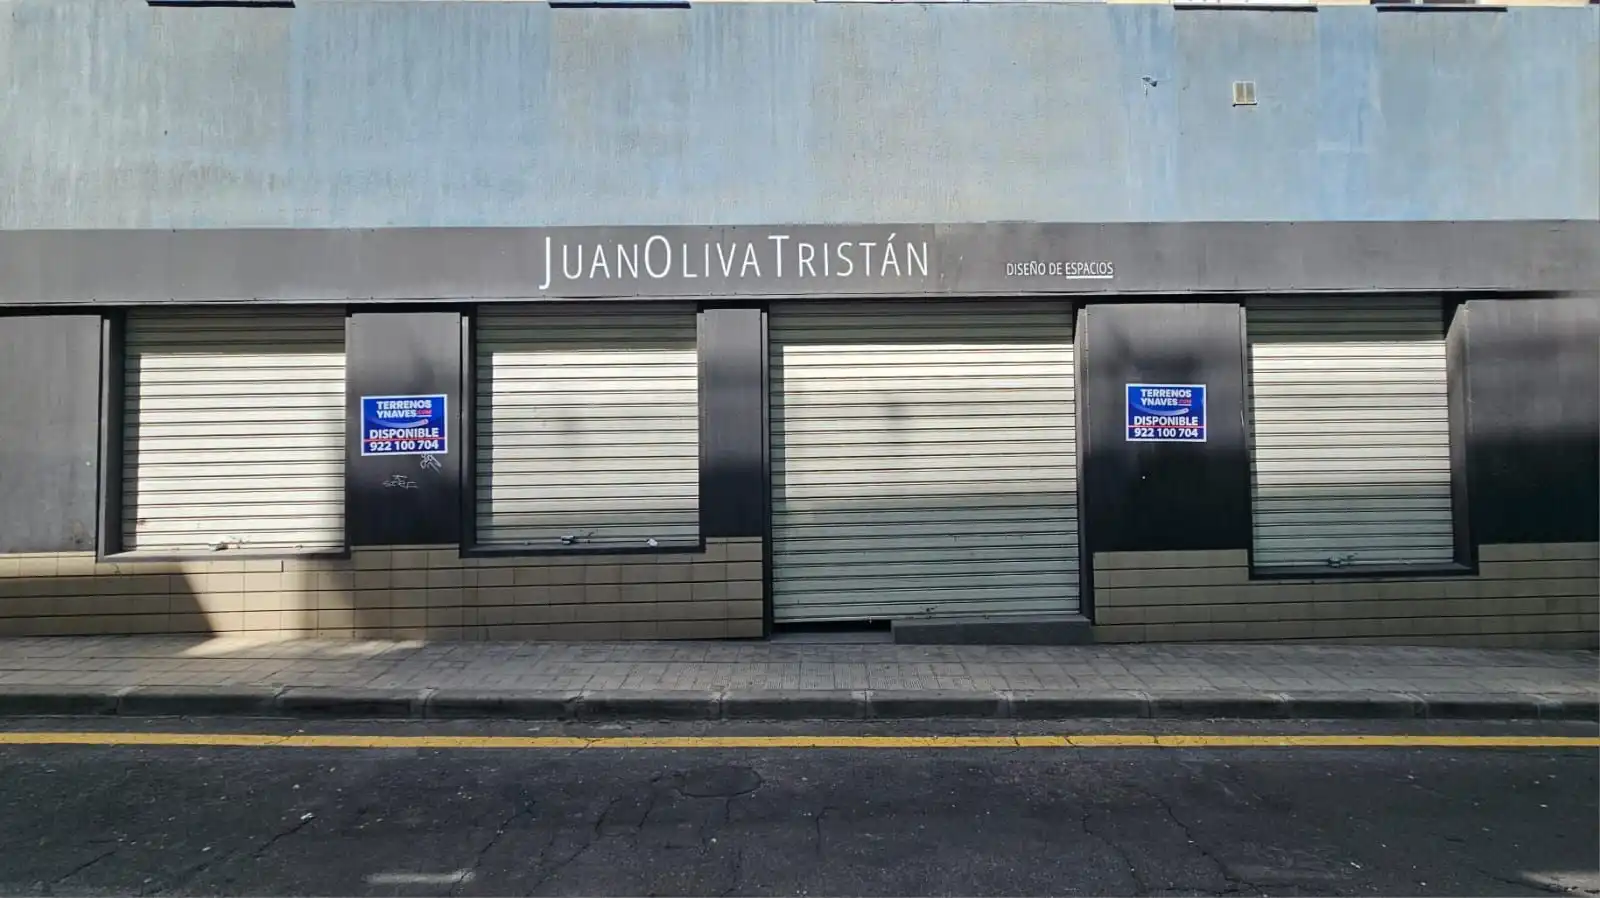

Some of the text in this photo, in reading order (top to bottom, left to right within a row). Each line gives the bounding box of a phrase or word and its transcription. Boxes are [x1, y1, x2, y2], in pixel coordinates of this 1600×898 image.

[1006, 260, 1114, 276] DISEÑO DE ESPACIOS
[1140, 388, 1192, 398] TERRENOS
[376, 399, 432, 410] TERRENOS
[1133, 415, 1198, 426] DISPONIBLE
[369, 427, 440, 439] DISPONIBLE
[1134, 428, 1198, 437] 922 100 704
[369, 440, 439, 451] 922 100 704
